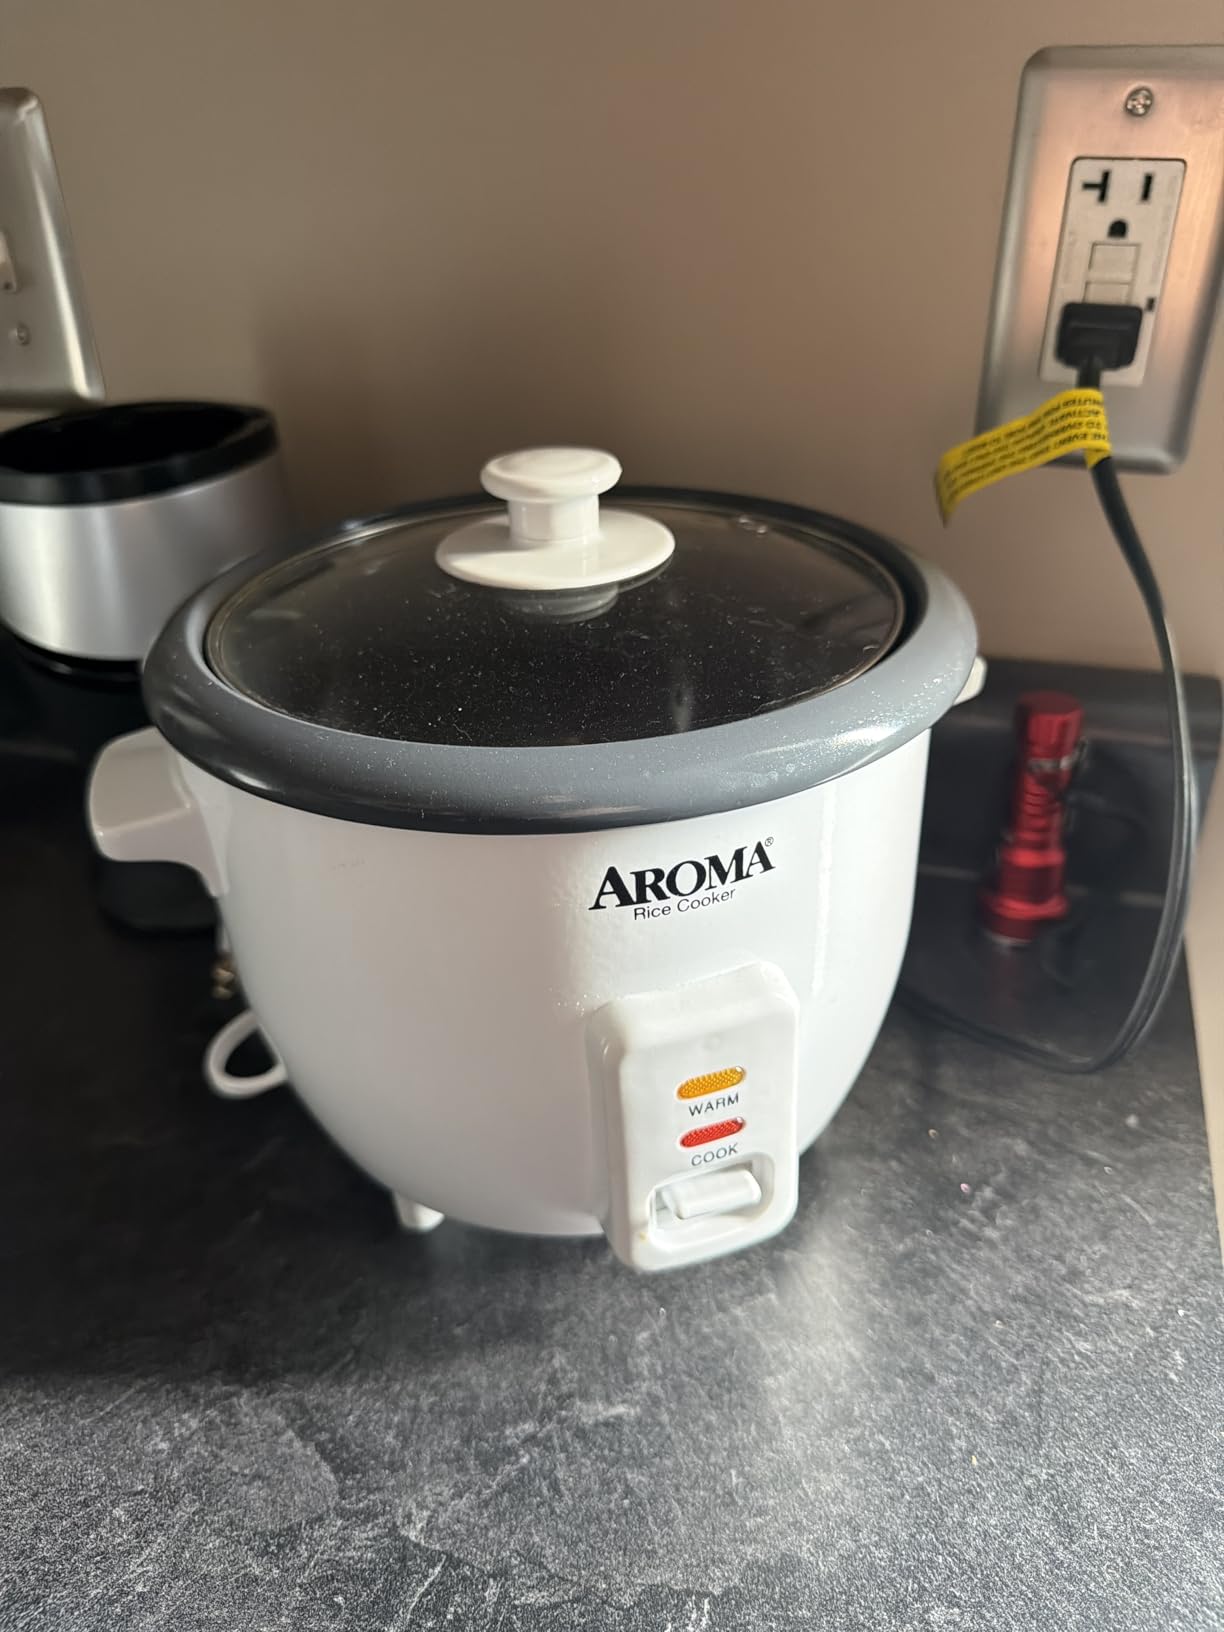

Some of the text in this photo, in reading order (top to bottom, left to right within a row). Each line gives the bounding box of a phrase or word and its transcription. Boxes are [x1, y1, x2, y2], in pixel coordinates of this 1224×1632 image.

[633, 888, 736, 921] Rice Cooker
[688, 1091, 739, 1117] WARM
[690, 1142, 739, 1167] COOK
